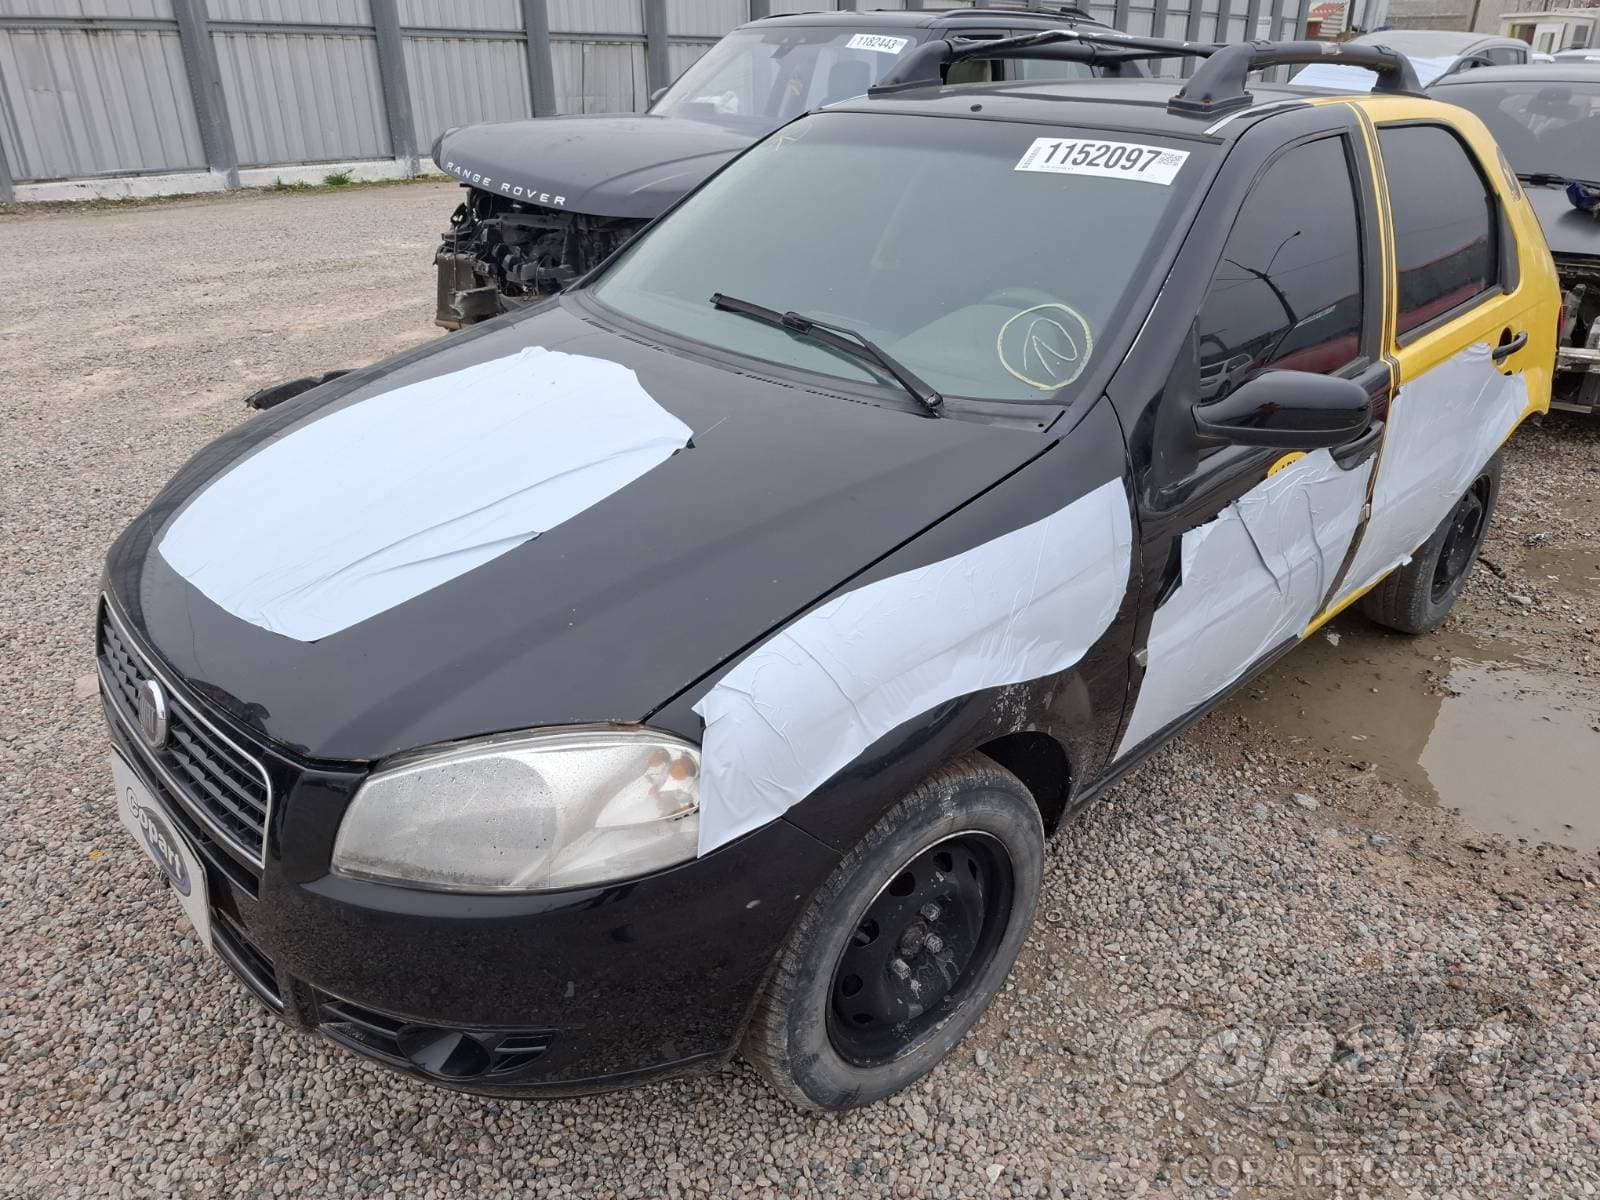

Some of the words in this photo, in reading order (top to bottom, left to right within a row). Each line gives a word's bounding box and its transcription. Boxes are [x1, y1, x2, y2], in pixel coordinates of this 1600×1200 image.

[857, 36, 898, 50] 1182443
[1044, 142, 1163, 172] 1152097
[446, 161, 492, 187] RANGE
[500, 182, 566, 206] ROVER
[125, 786, 183, 880] Copart
